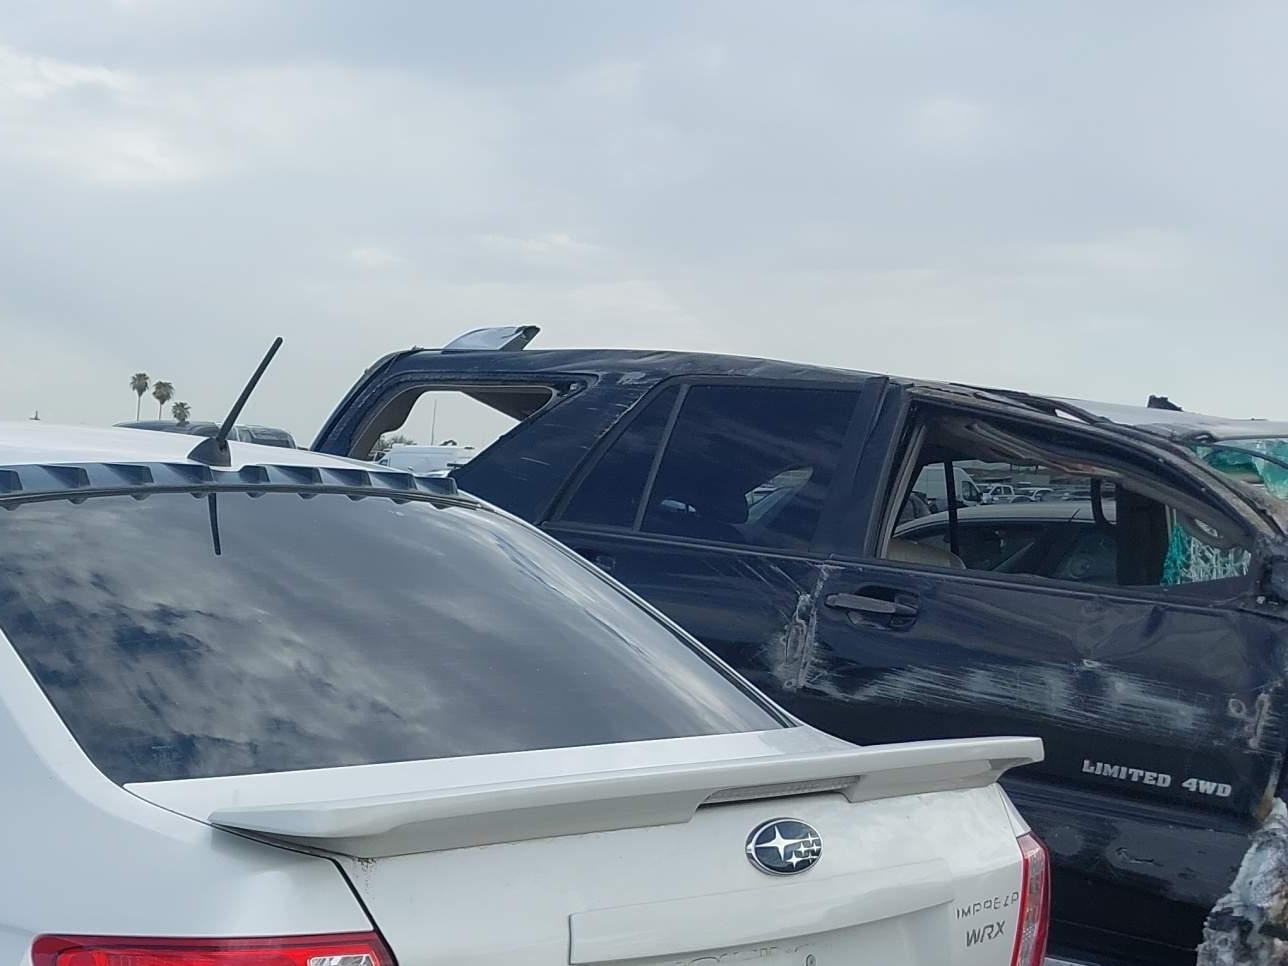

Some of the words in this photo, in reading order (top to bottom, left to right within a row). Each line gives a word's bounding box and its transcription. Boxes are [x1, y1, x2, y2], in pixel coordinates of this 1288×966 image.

[1082, 759, 1172, 788] LIMITED
[1181, 777, 1233, 797] 4WD
[966, 920, 1006, 947] WRX
